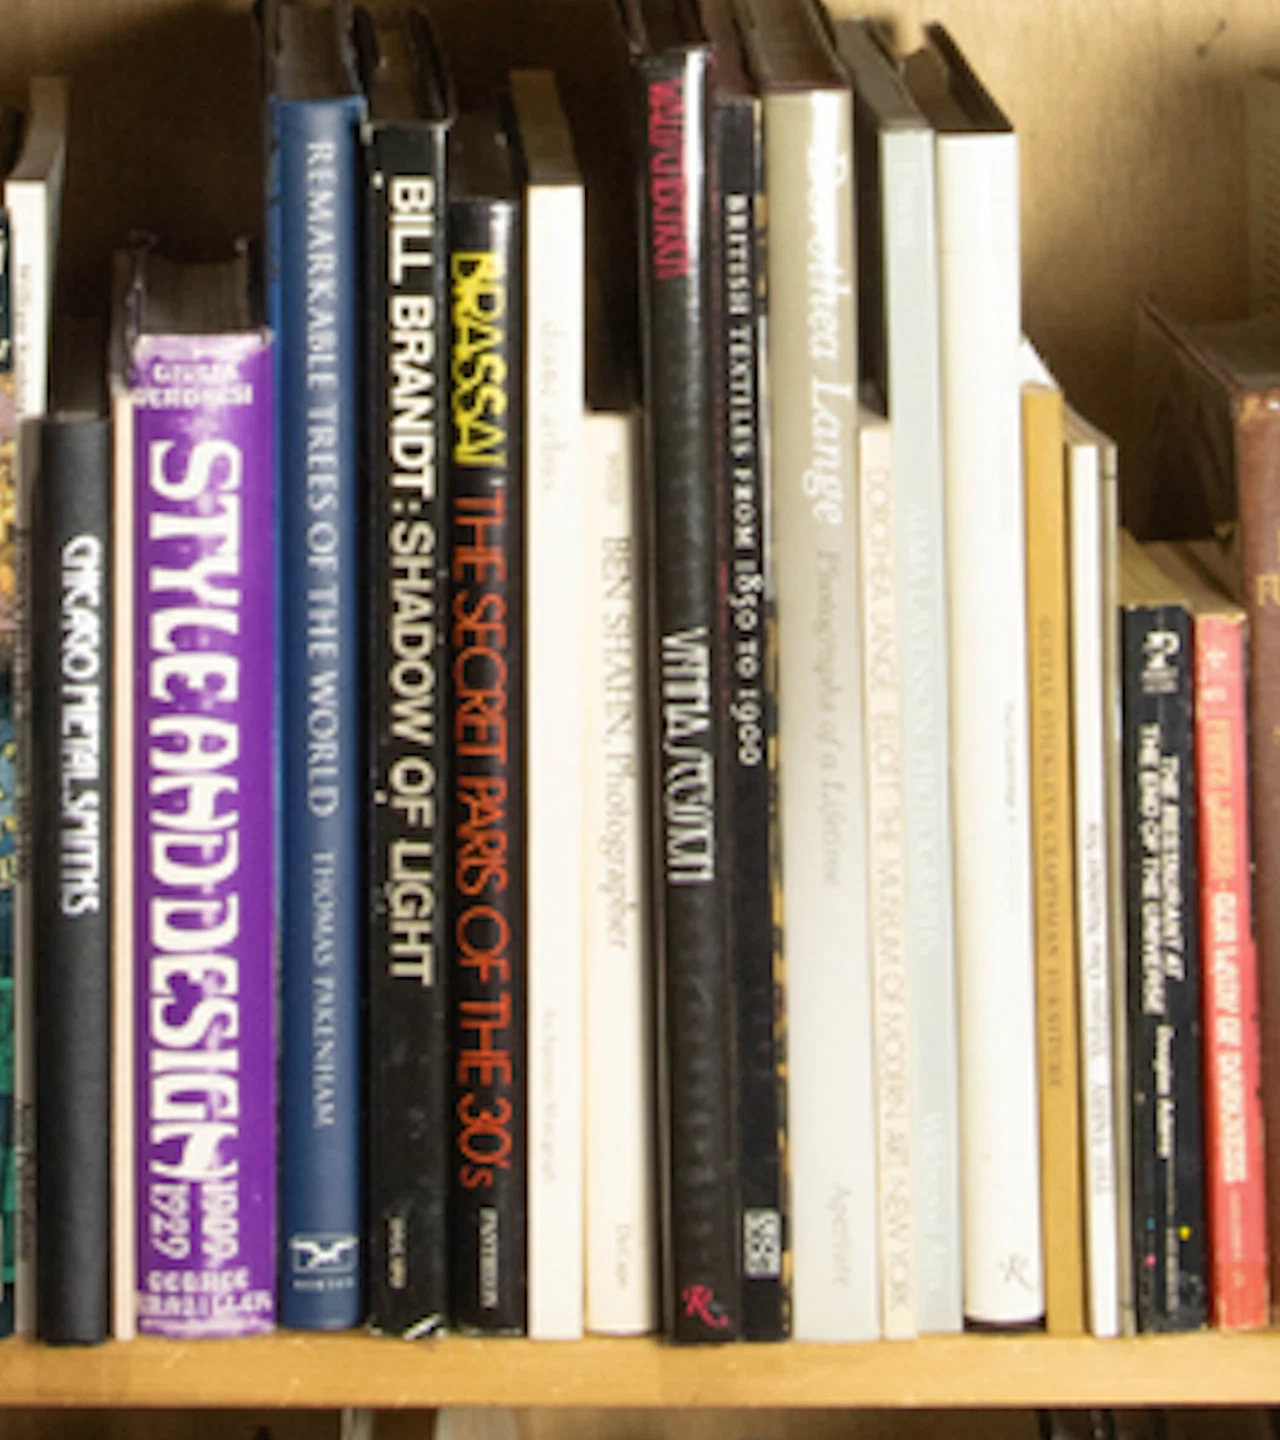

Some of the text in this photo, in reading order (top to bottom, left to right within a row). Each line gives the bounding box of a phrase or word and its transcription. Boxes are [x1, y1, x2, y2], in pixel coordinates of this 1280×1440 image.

[385, 178, 436, 984] BILL BRANDT: SHADOW OF LIGHT
[456, 490, 501, 581] THE
[303, 140, 342, 1128] REMARKABLE TREES OF THE WORLD THOMAS PAKENHAM
[456, 589, 502, 766] SECRET
[148, 440, 246, 1183] STYLE AND DESIGN
[458, 775, 506, 895] PARIS
[460, 905, 508, 982] OF
[460, 991, 510, 1085] THE
[460, 1094, 508, 1188] 30's
[148, 1183, 189, 1259] 1929
[199, 1183, 237, 1259] 1909
